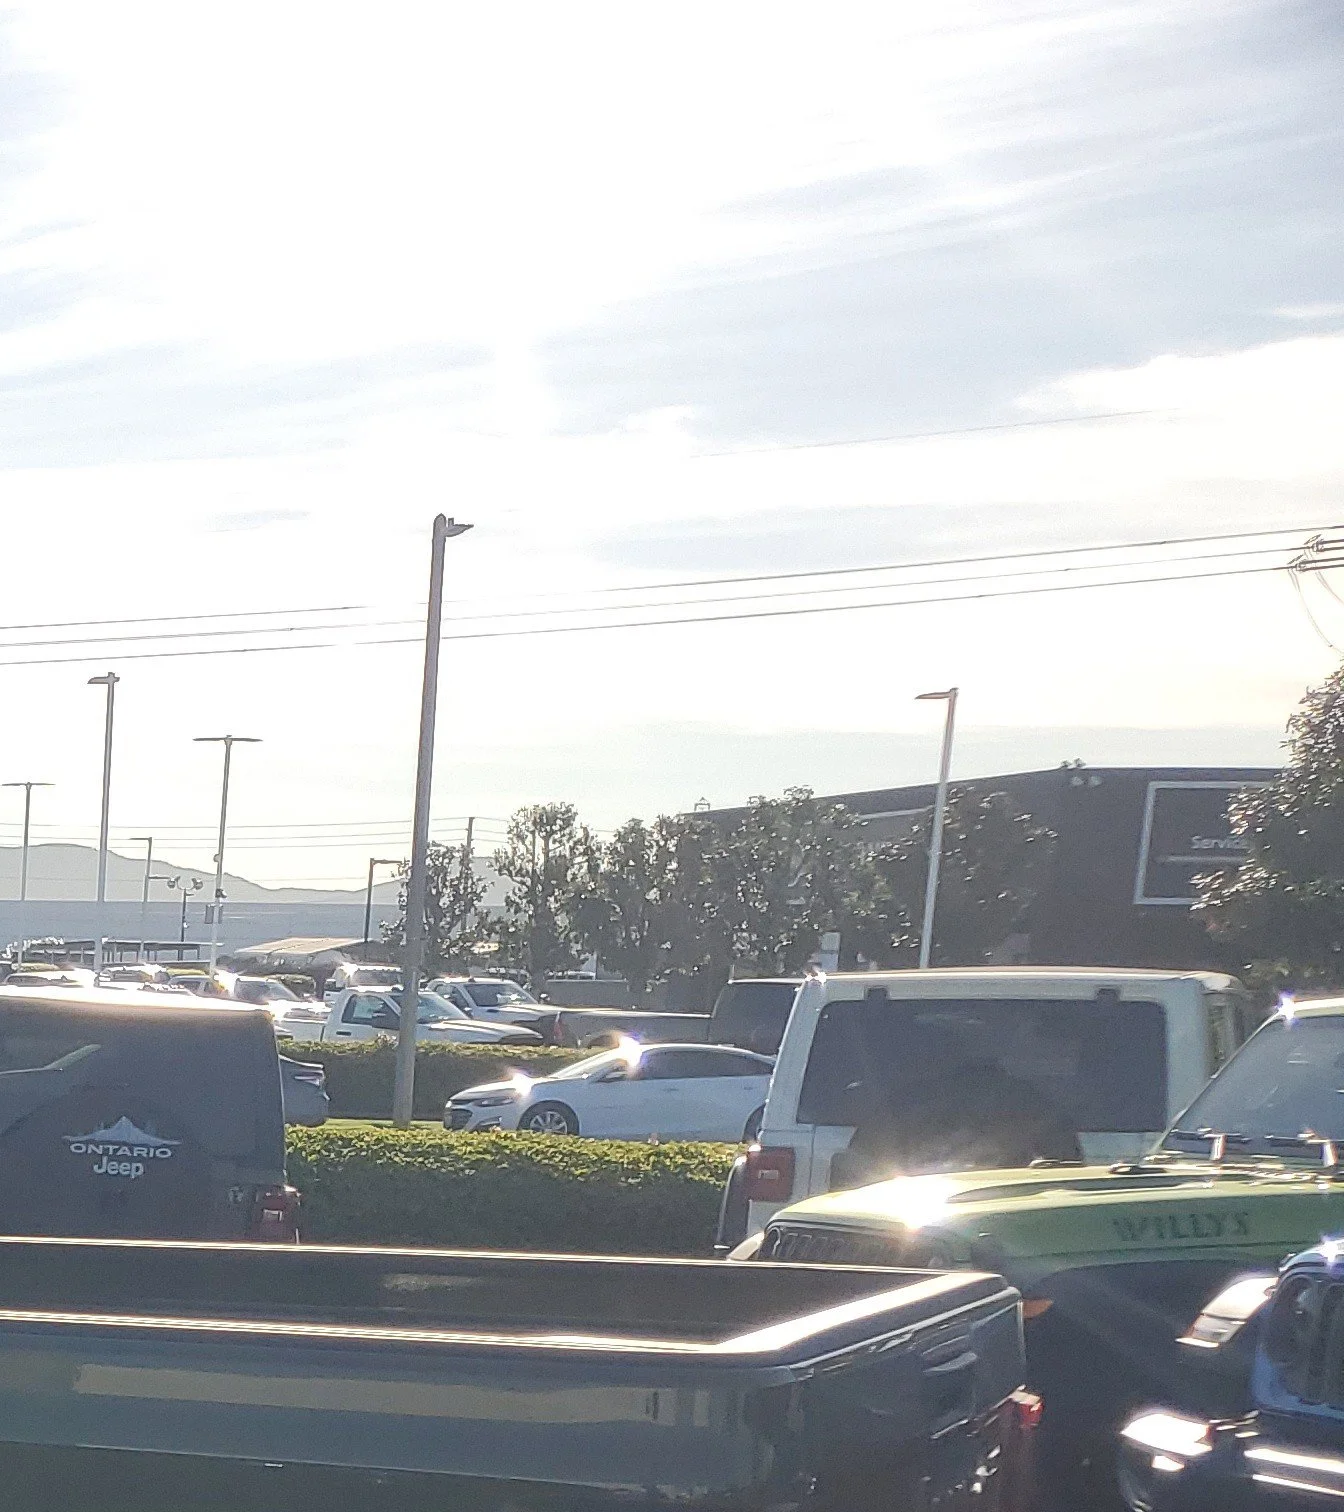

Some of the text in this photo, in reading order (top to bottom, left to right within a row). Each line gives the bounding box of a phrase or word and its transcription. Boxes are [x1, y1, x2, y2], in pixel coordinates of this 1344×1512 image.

[69, 1143, 172, 1158] ONTARIO
[93, 1156, 144, 1179] Jeep
[1113, 1211, 1249, 1241] WILLYS
